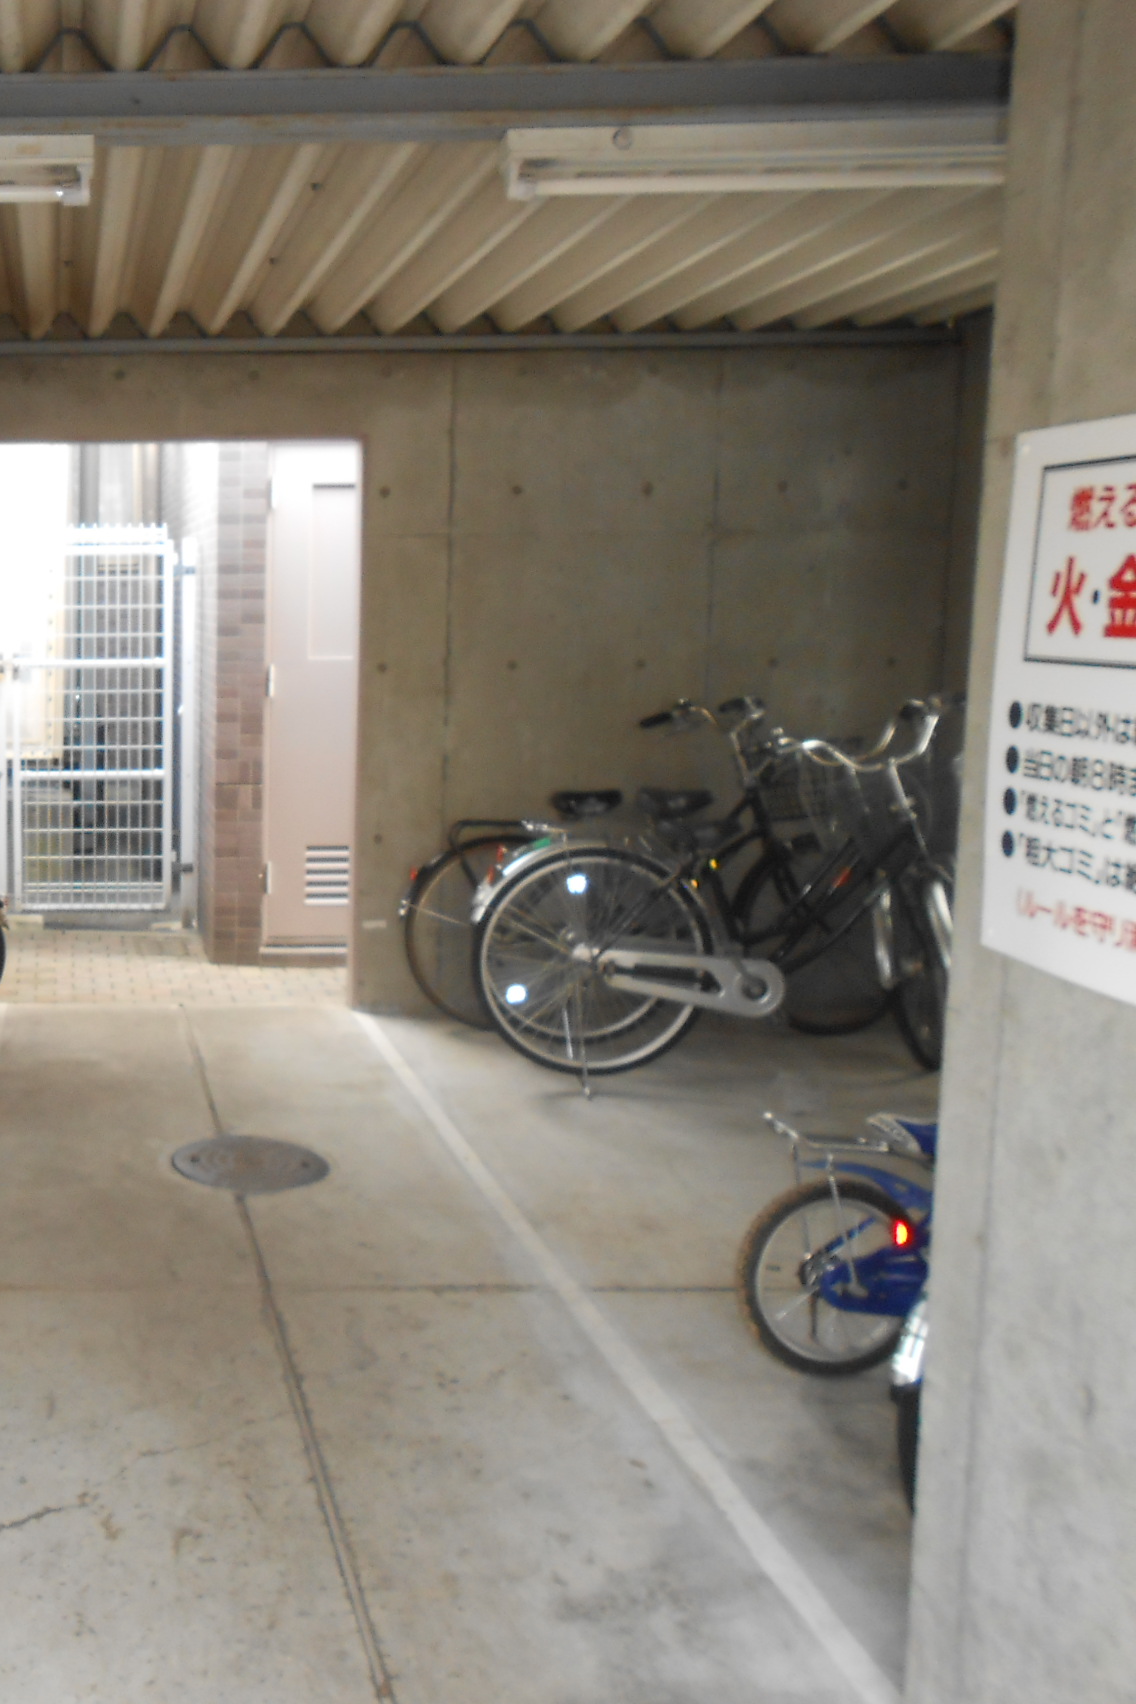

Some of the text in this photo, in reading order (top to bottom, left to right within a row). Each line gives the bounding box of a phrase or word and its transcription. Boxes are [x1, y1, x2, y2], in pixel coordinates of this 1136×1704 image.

[1025, 701, 1136, 746] 収集日以外は
